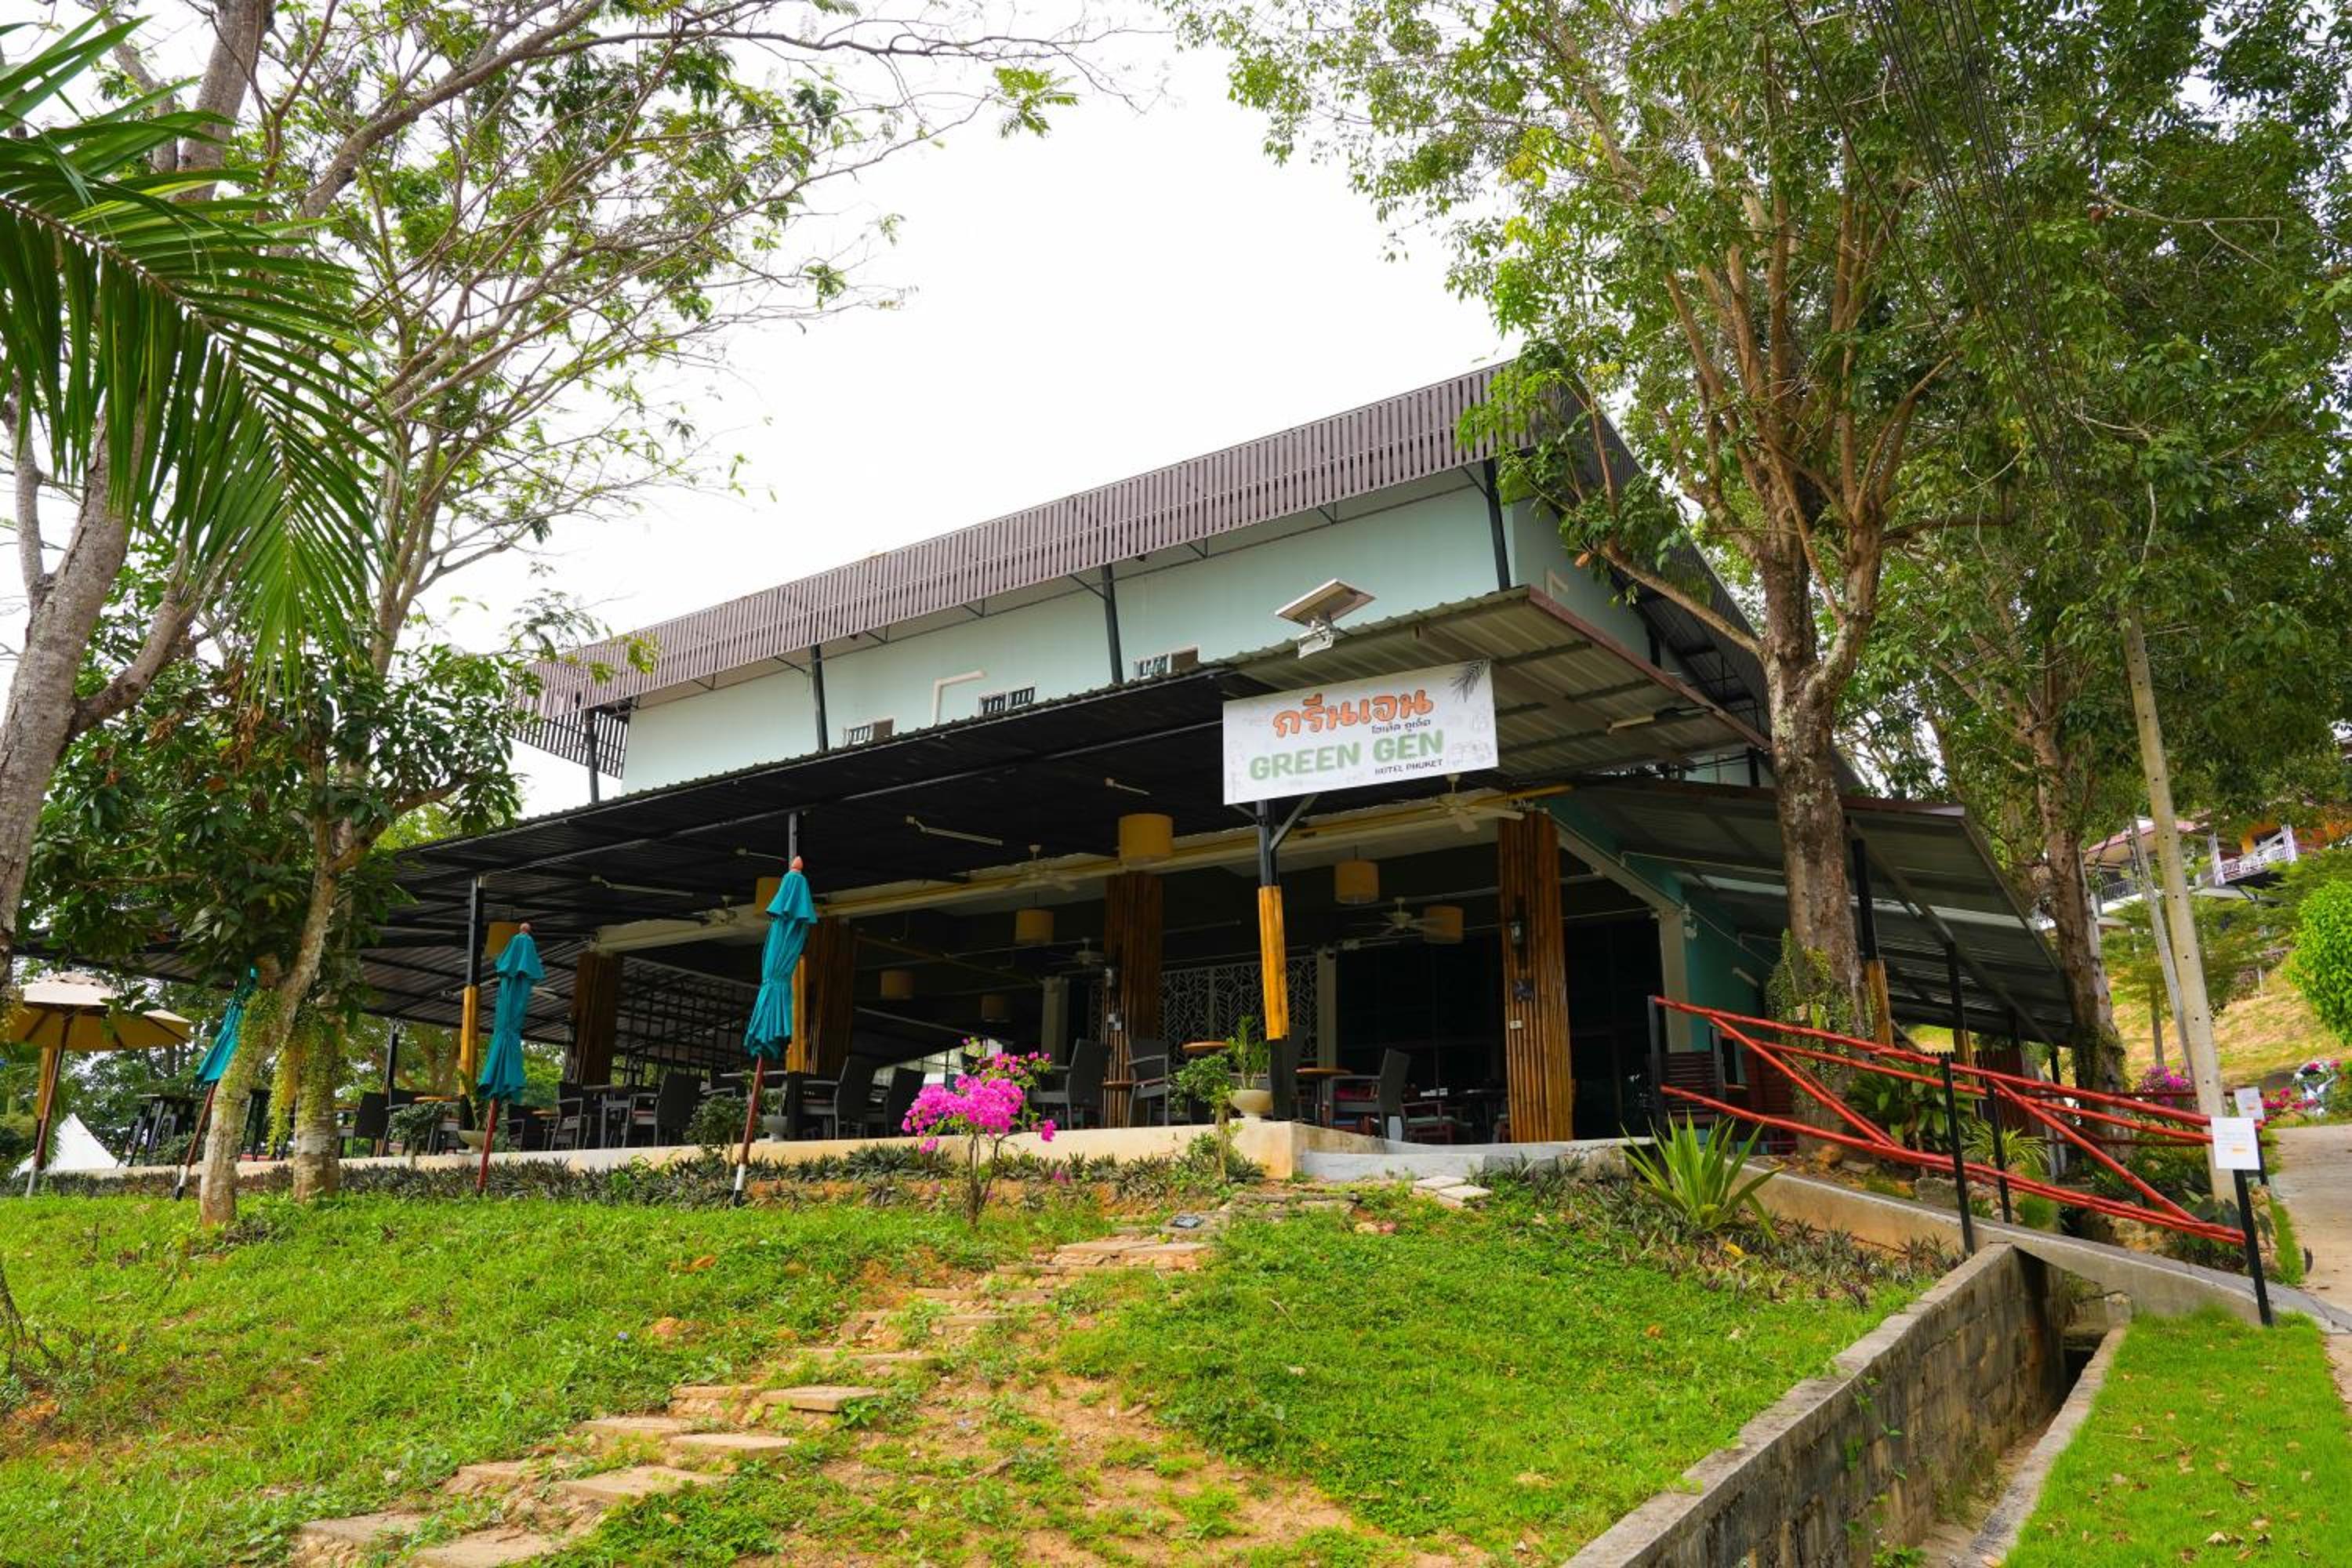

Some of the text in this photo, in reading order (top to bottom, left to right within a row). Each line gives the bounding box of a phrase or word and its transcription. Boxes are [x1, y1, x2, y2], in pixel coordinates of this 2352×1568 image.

[1249, 729, 1444, 780] GREEN GEN
[1374, 759, 1443, 775] HOTEL PHUKET
